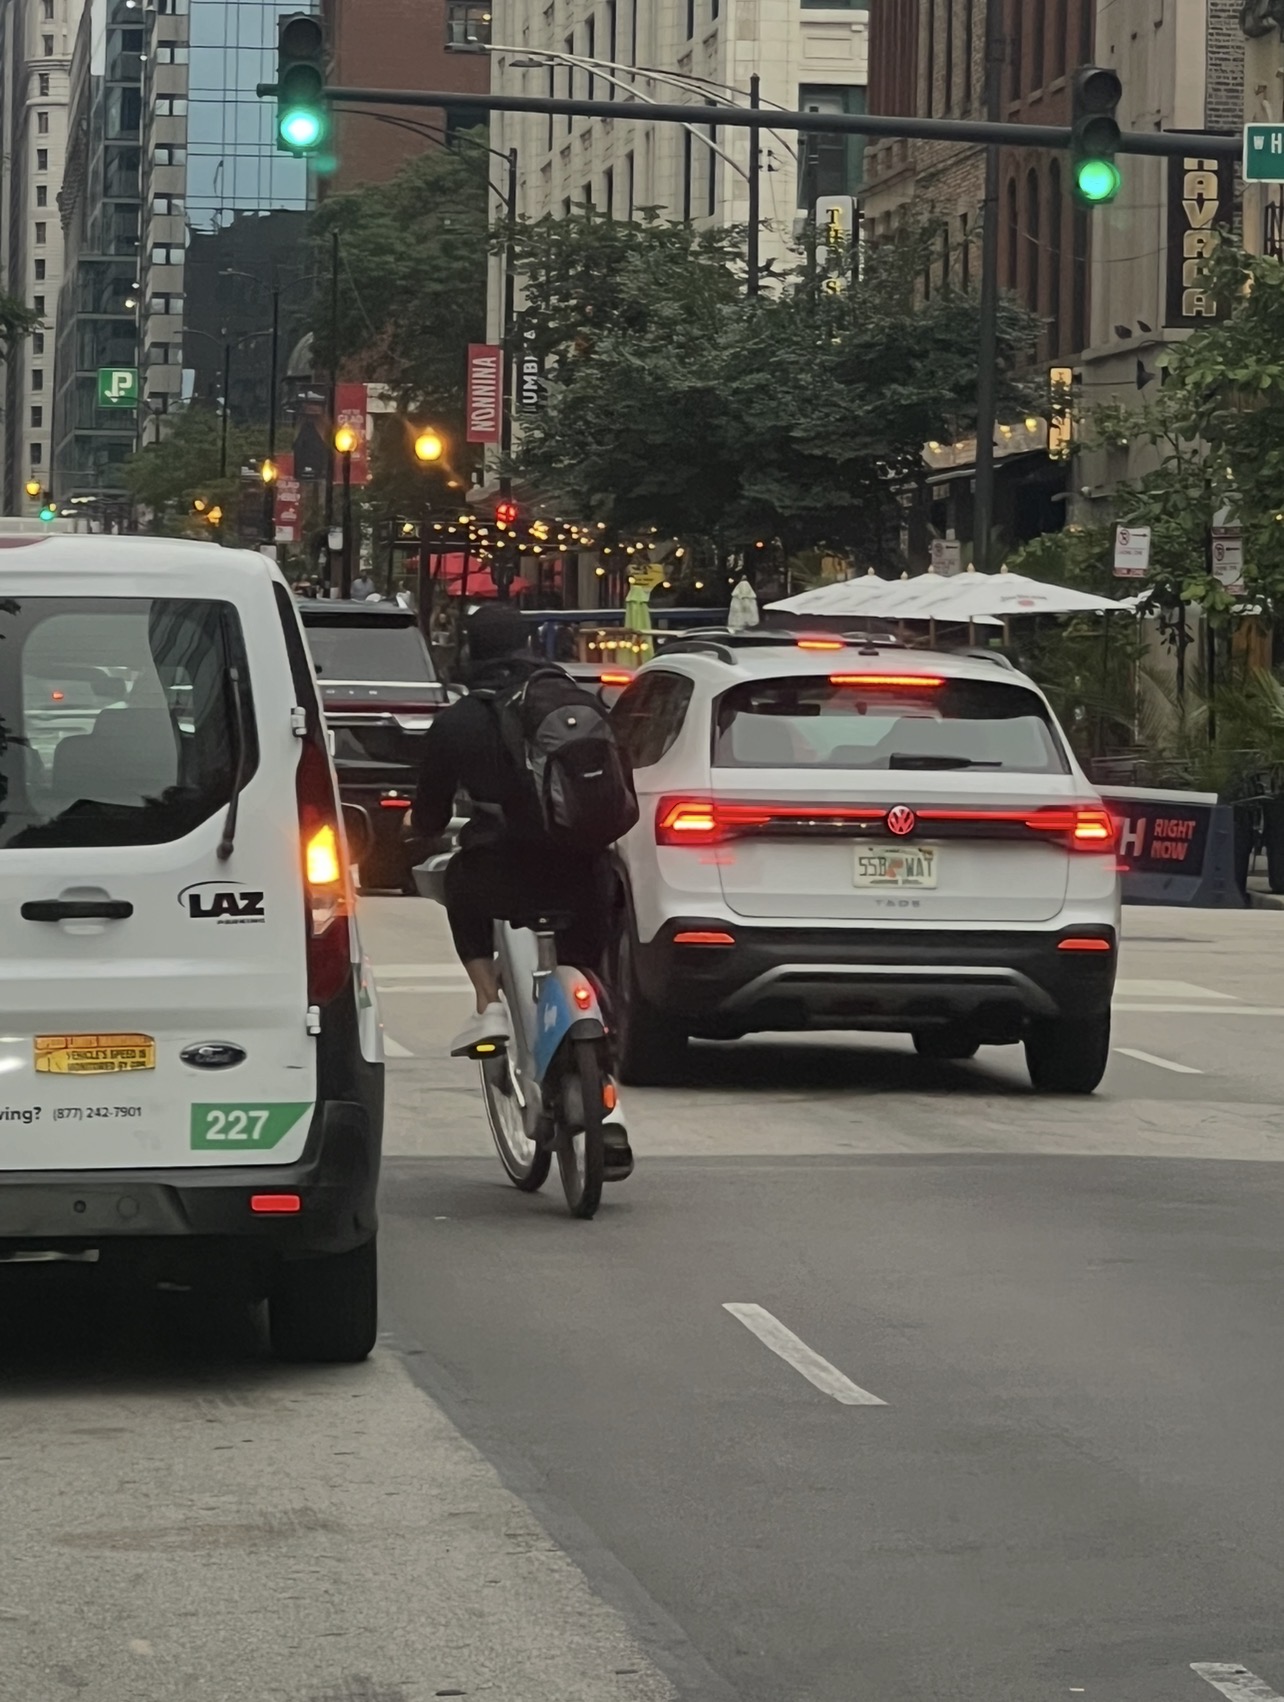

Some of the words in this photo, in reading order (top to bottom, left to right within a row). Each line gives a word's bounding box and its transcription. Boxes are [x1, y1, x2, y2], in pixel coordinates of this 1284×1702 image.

[471, 356, 497, 432] NONNINA
[1154, 818, 1196, 840] RIGHT
[1151, 840, 1188, 861] NOW
[188, 891, 265, 918] LAZ
[52, 1108, 84, 1122] (877)
[86, 1106, 142, 1118] 242-7901
[205, 1110, 270, 1140] 227
